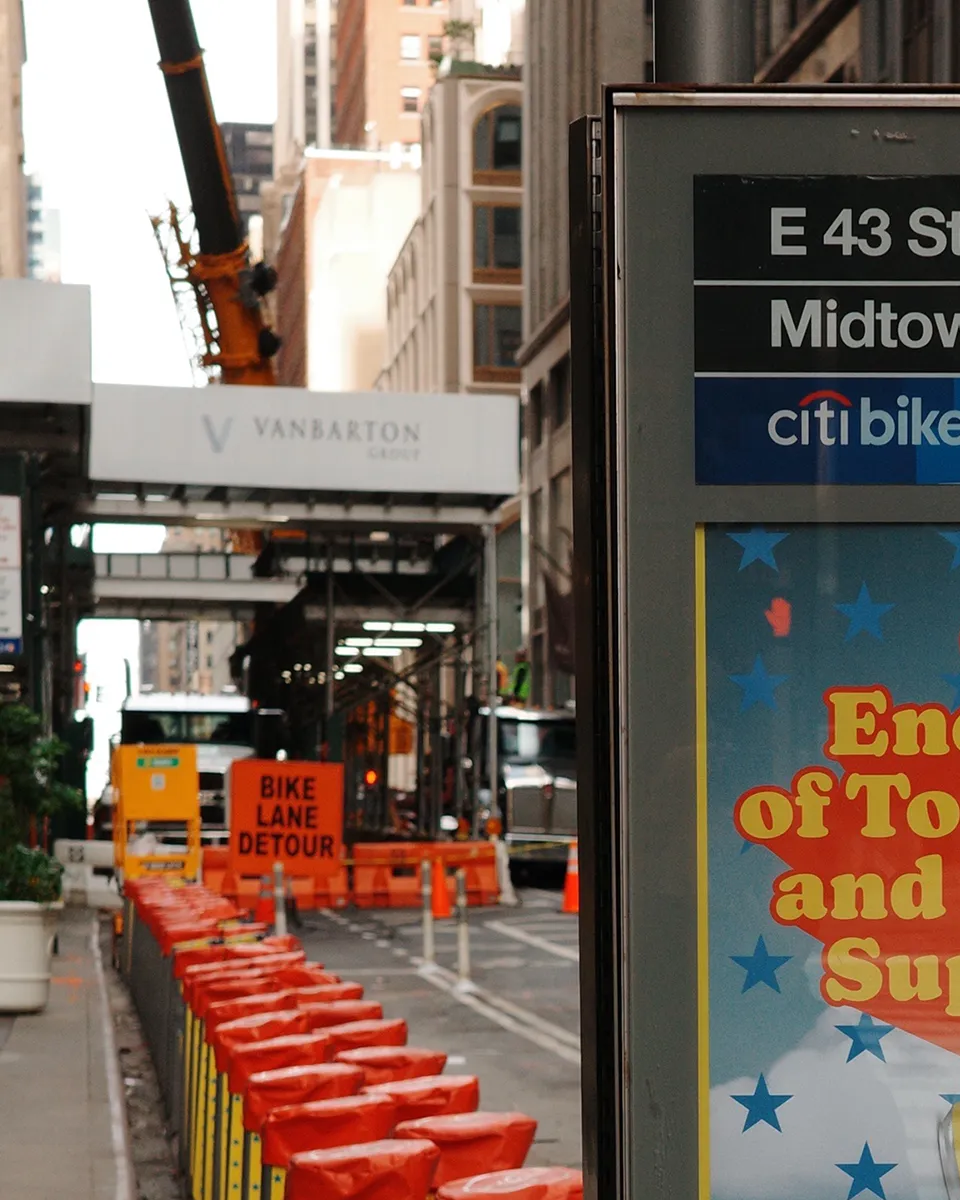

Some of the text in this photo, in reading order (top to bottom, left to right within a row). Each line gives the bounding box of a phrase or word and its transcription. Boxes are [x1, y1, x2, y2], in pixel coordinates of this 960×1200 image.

[770, 207, 807, 256] E
[823, 208, 892, 257] 43
[253, 415, 421, 444] VANBARTON
[768, 398, 850, 446] citi
[260, 775, 316, 800] BIKE
[739, 771, 833, 839] of
[257, 804, 318, 829] LANE
[239, 832, 334, 857] DETOUR
[775, 854, 946, 920] and
